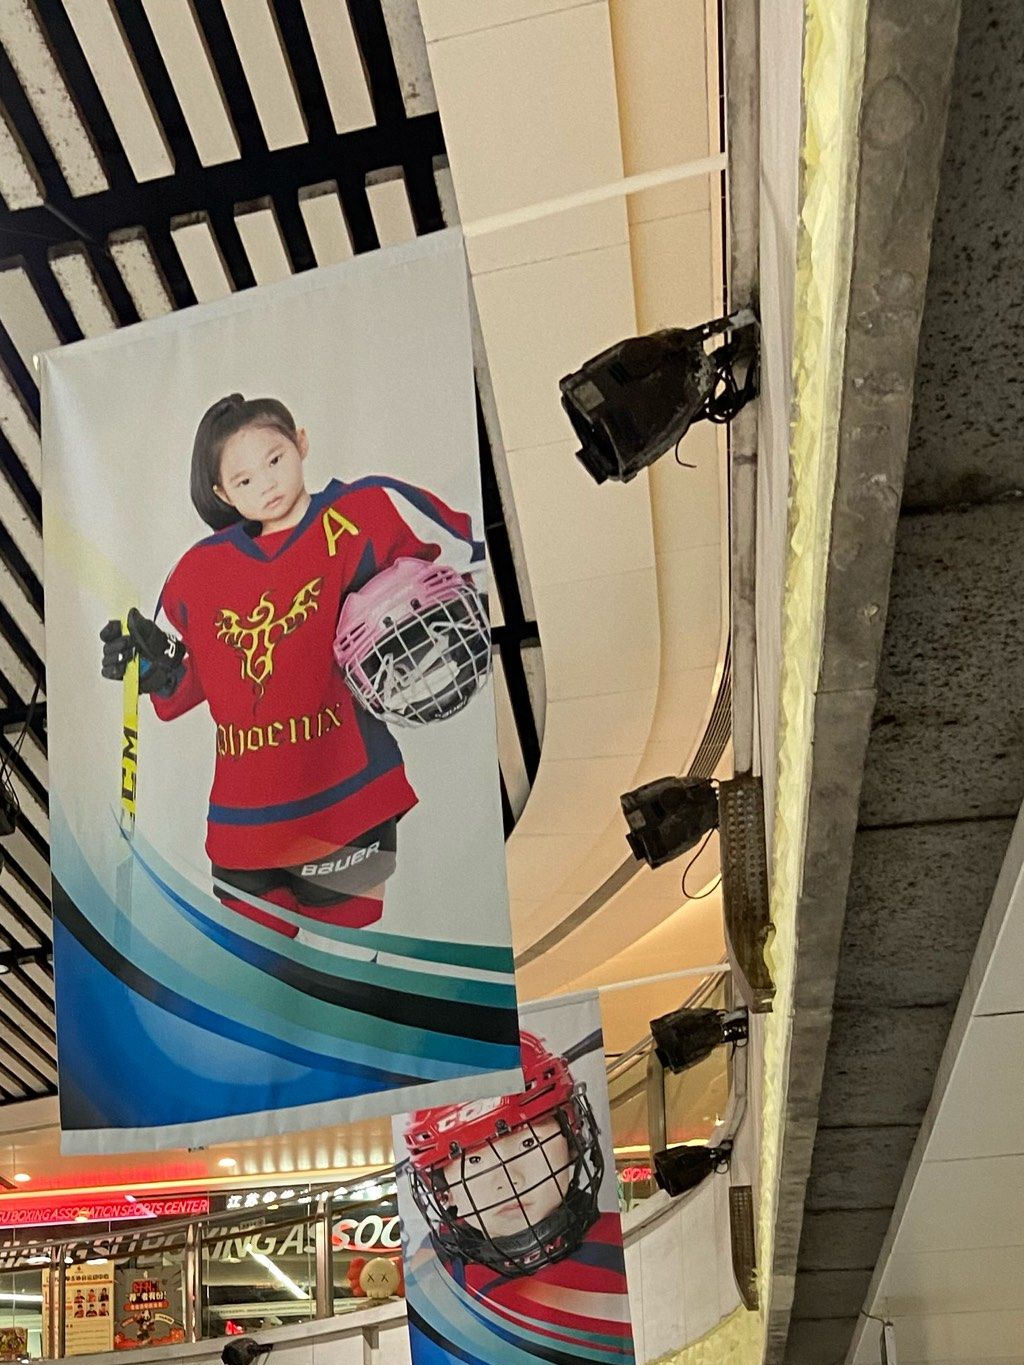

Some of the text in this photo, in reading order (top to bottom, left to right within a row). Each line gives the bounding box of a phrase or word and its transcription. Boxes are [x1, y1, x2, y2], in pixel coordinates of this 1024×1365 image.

[321, 507, 360, 557] A
[301, 841, 380, 876] BAUER
[10, 1207, 52, 1223] BOXING
[51, 1204, 120, 1221] ASSOCIATION
[119, 1201, 164, 1216] SPORTS
[164, 1198, 209, 1214] CENTER
